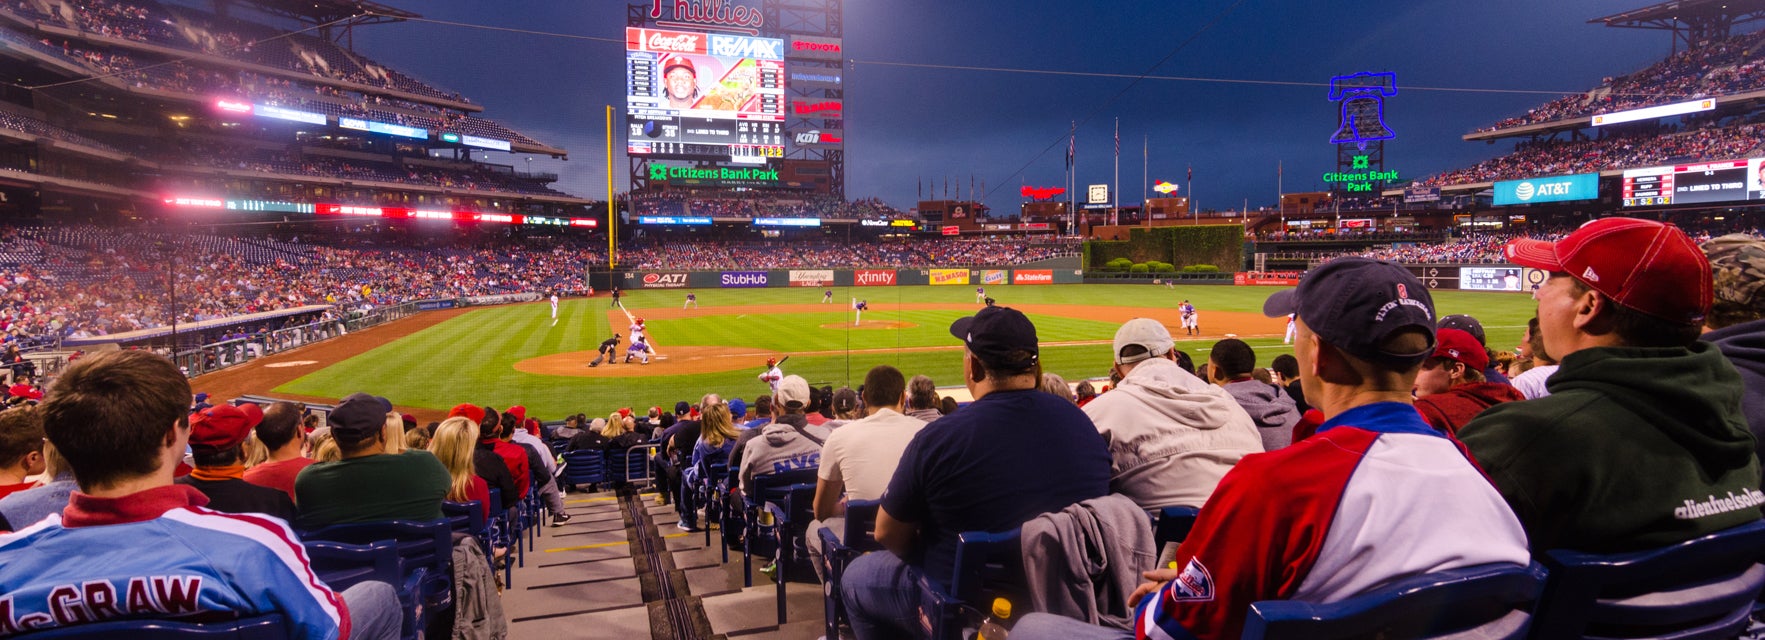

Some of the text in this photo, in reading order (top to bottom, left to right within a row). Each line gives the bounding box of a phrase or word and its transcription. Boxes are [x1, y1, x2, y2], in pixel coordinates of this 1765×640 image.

[649, 33, 699, 52] Coca-Cola
[713, 37, 778, 60] RE/MAX
[805, 42, 840, 53] TOYOTA
[760, 148, 782, 157] 1 2 2
[670, 167, 778, 180] Citizens Bank Park
[1323, 170, 1398, 182] Citizens Bank
[1348, 182, 1372, 191] Park
[1537, 182, 1572, 196] AT&T
[658, 274, 687, 282] ATI
[722, 274, 767, 284] StubHub
[858, 272, 894, 284] xfinity
[985, 272, 1003, 283] Gulf
[1397, 283, 1408, 298] 8
